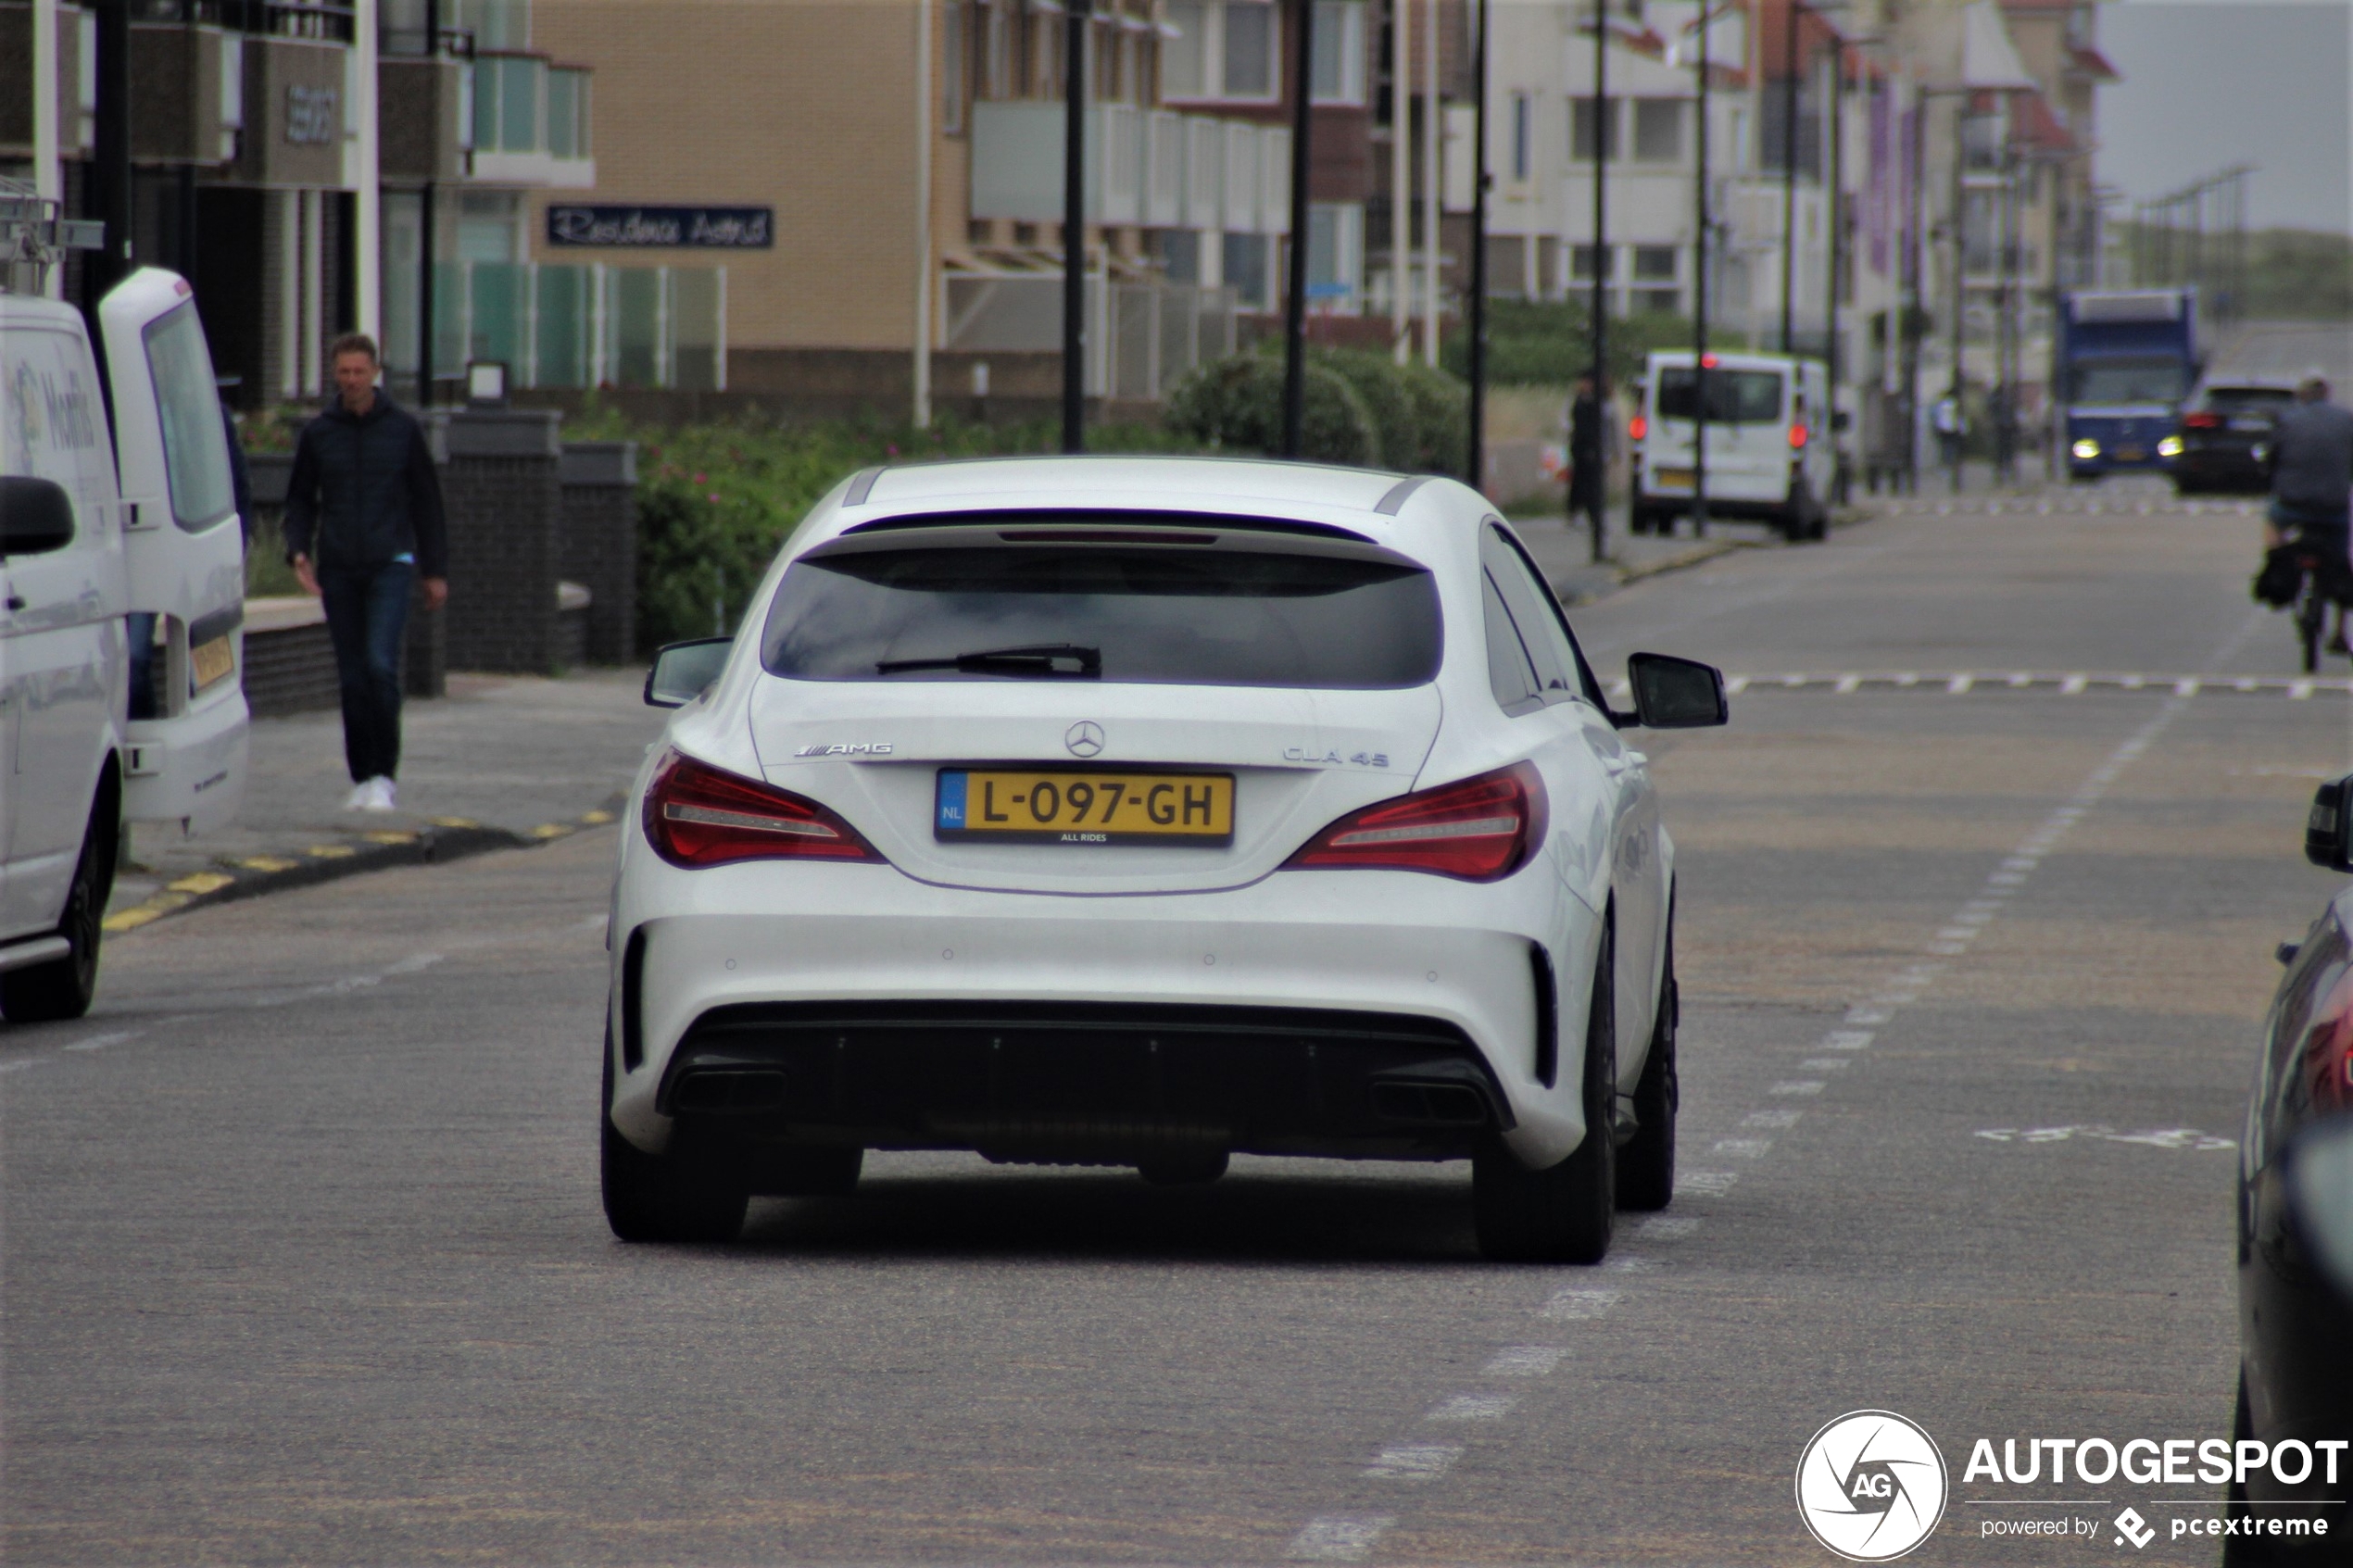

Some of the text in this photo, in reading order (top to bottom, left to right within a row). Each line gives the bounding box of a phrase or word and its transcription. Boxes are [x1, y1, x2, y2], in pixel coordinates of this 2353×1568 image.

[824, 744, 892, 755] AMG
[1283, 747, 1390, 768] CLA 45
[984, 780, 1213, 826] L-097-GH
[942, 807, 963, 820] NL
[1061, 834, 1107, 842] ALL RIDES
